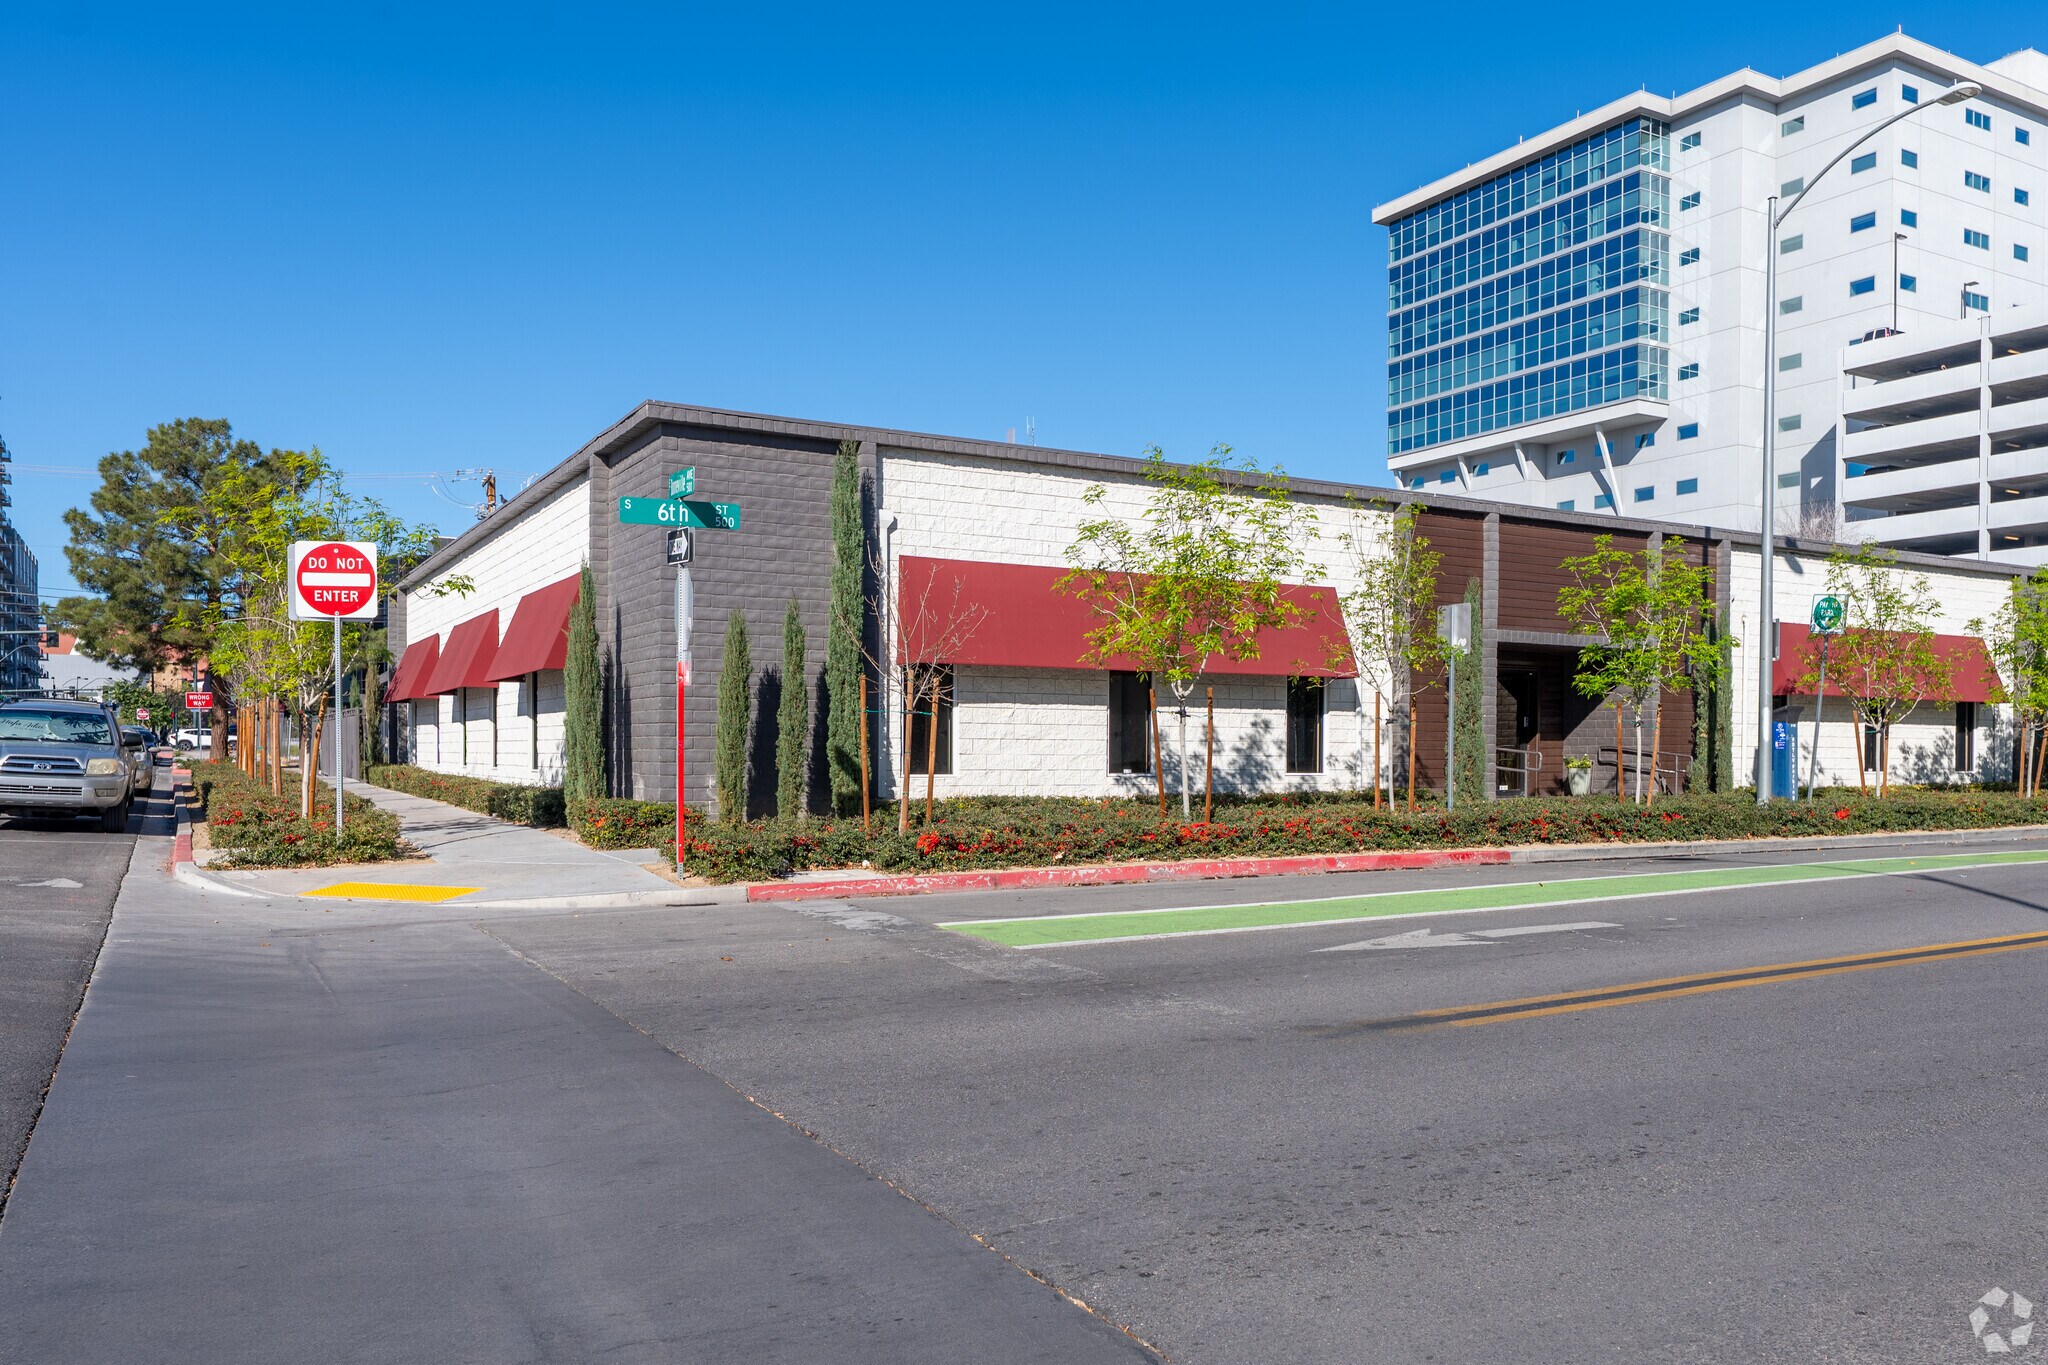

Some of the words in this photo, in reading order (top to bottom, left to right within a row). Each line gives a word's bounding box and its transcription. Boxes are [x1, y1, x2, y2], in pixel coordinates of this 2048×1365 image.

[624, 499, 632, 509] S
[657, 503, 689, 522] 6th
[715, 505, 728, 515] ST
[715, 516, 735, 527] 500
[308, 557, 328, 569] DO
[336, 558, 364, 570] NOT
[314, 590, 359, 602] ENTER
